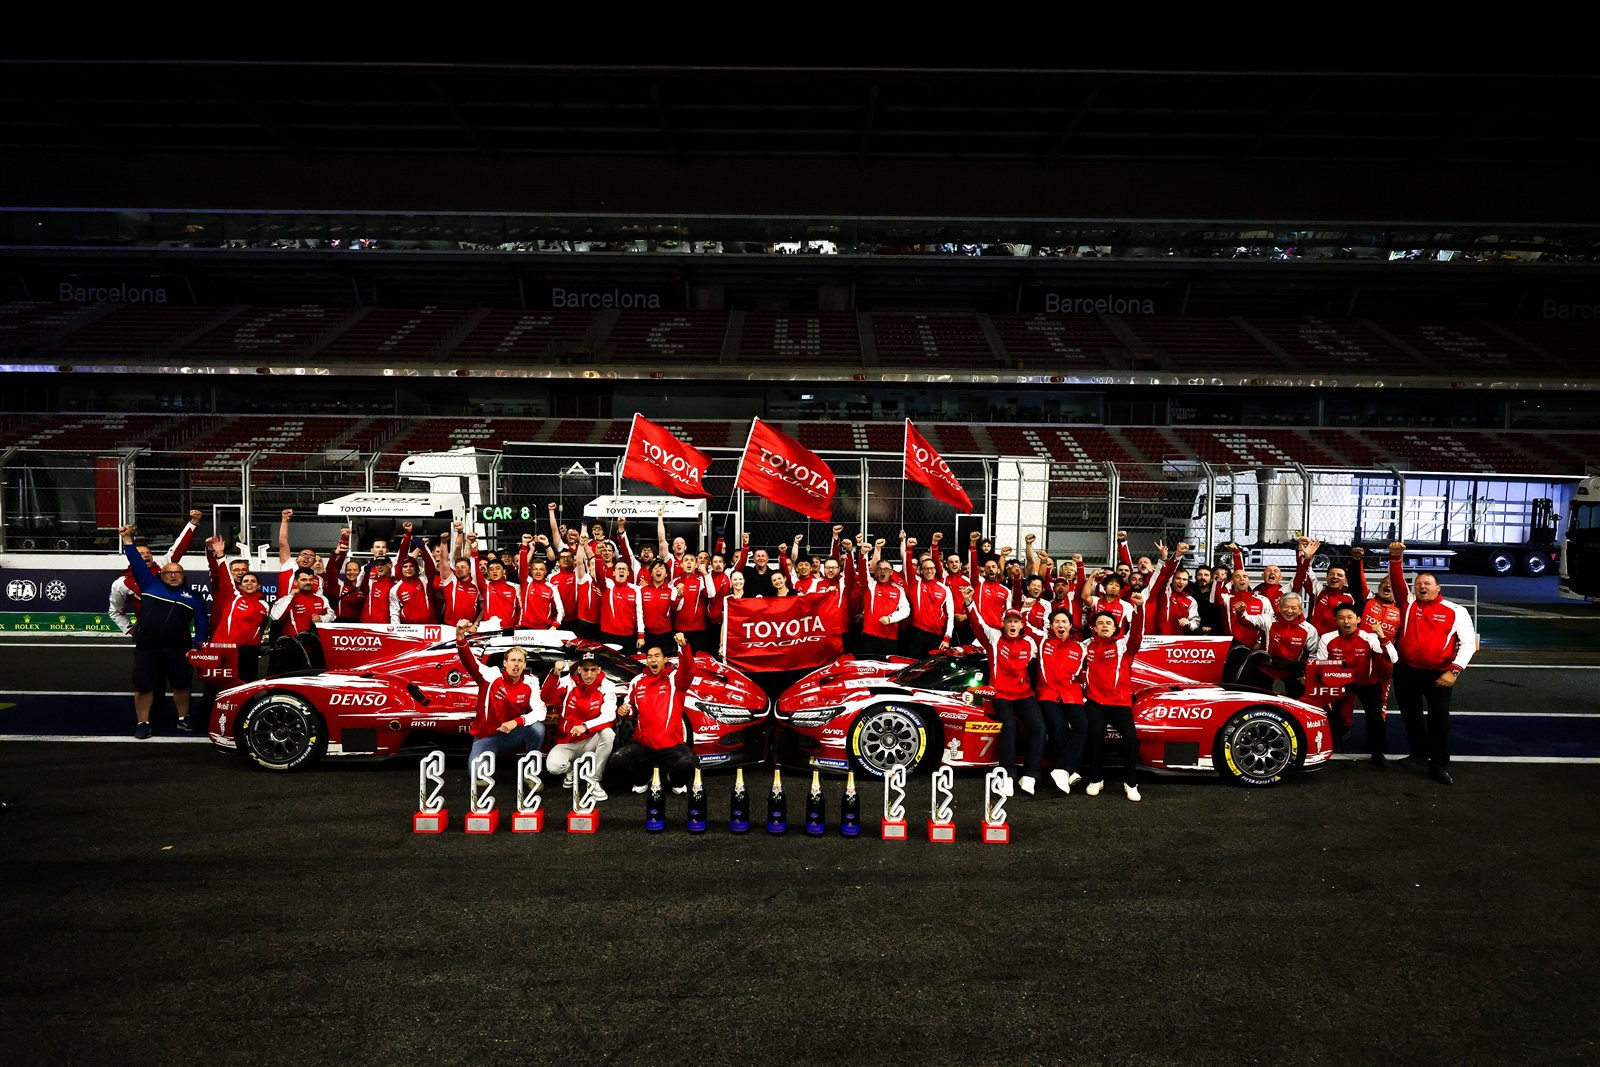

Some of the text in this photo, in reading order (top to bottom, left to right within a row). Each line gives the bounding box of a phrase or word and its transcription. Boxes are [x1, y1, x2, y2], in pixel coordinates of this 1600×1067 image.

[59, 280, 168, 303] Barcelona
[551, 287, 662, 309] Barcelona
[1045, 292, 1155, 314] Barcelona
[642, 439, 699, 482] TOYOTA
[760, 447, 829, 494] TOYOTA
[756, 463, 826, 498] RACING
[482, 506, 530, 520] CAR 8
[191, 584, 209, 592] FIA
[425, 628, 440, 640] HY
[742, 616, 826, 639] TOYOTA
[332, 636, 382, 646] TOYOTA
[741, 635, 827, 648] RACING
[1165, 648, 1216, 659] TOYOTA
[203, 668, 233, 677] JFE
[1309, 686, 1340, 696] JFE
[329, 693, 387, 706] DENSO
[896, 706, 921, 727] MICHELIN
[1154, 706, 1213, 720] DENSO
[970, 723, 1001, 731] DHL
[1306, 720, 1320, 729] Mobil
[978, 736, 995, 758] 7
